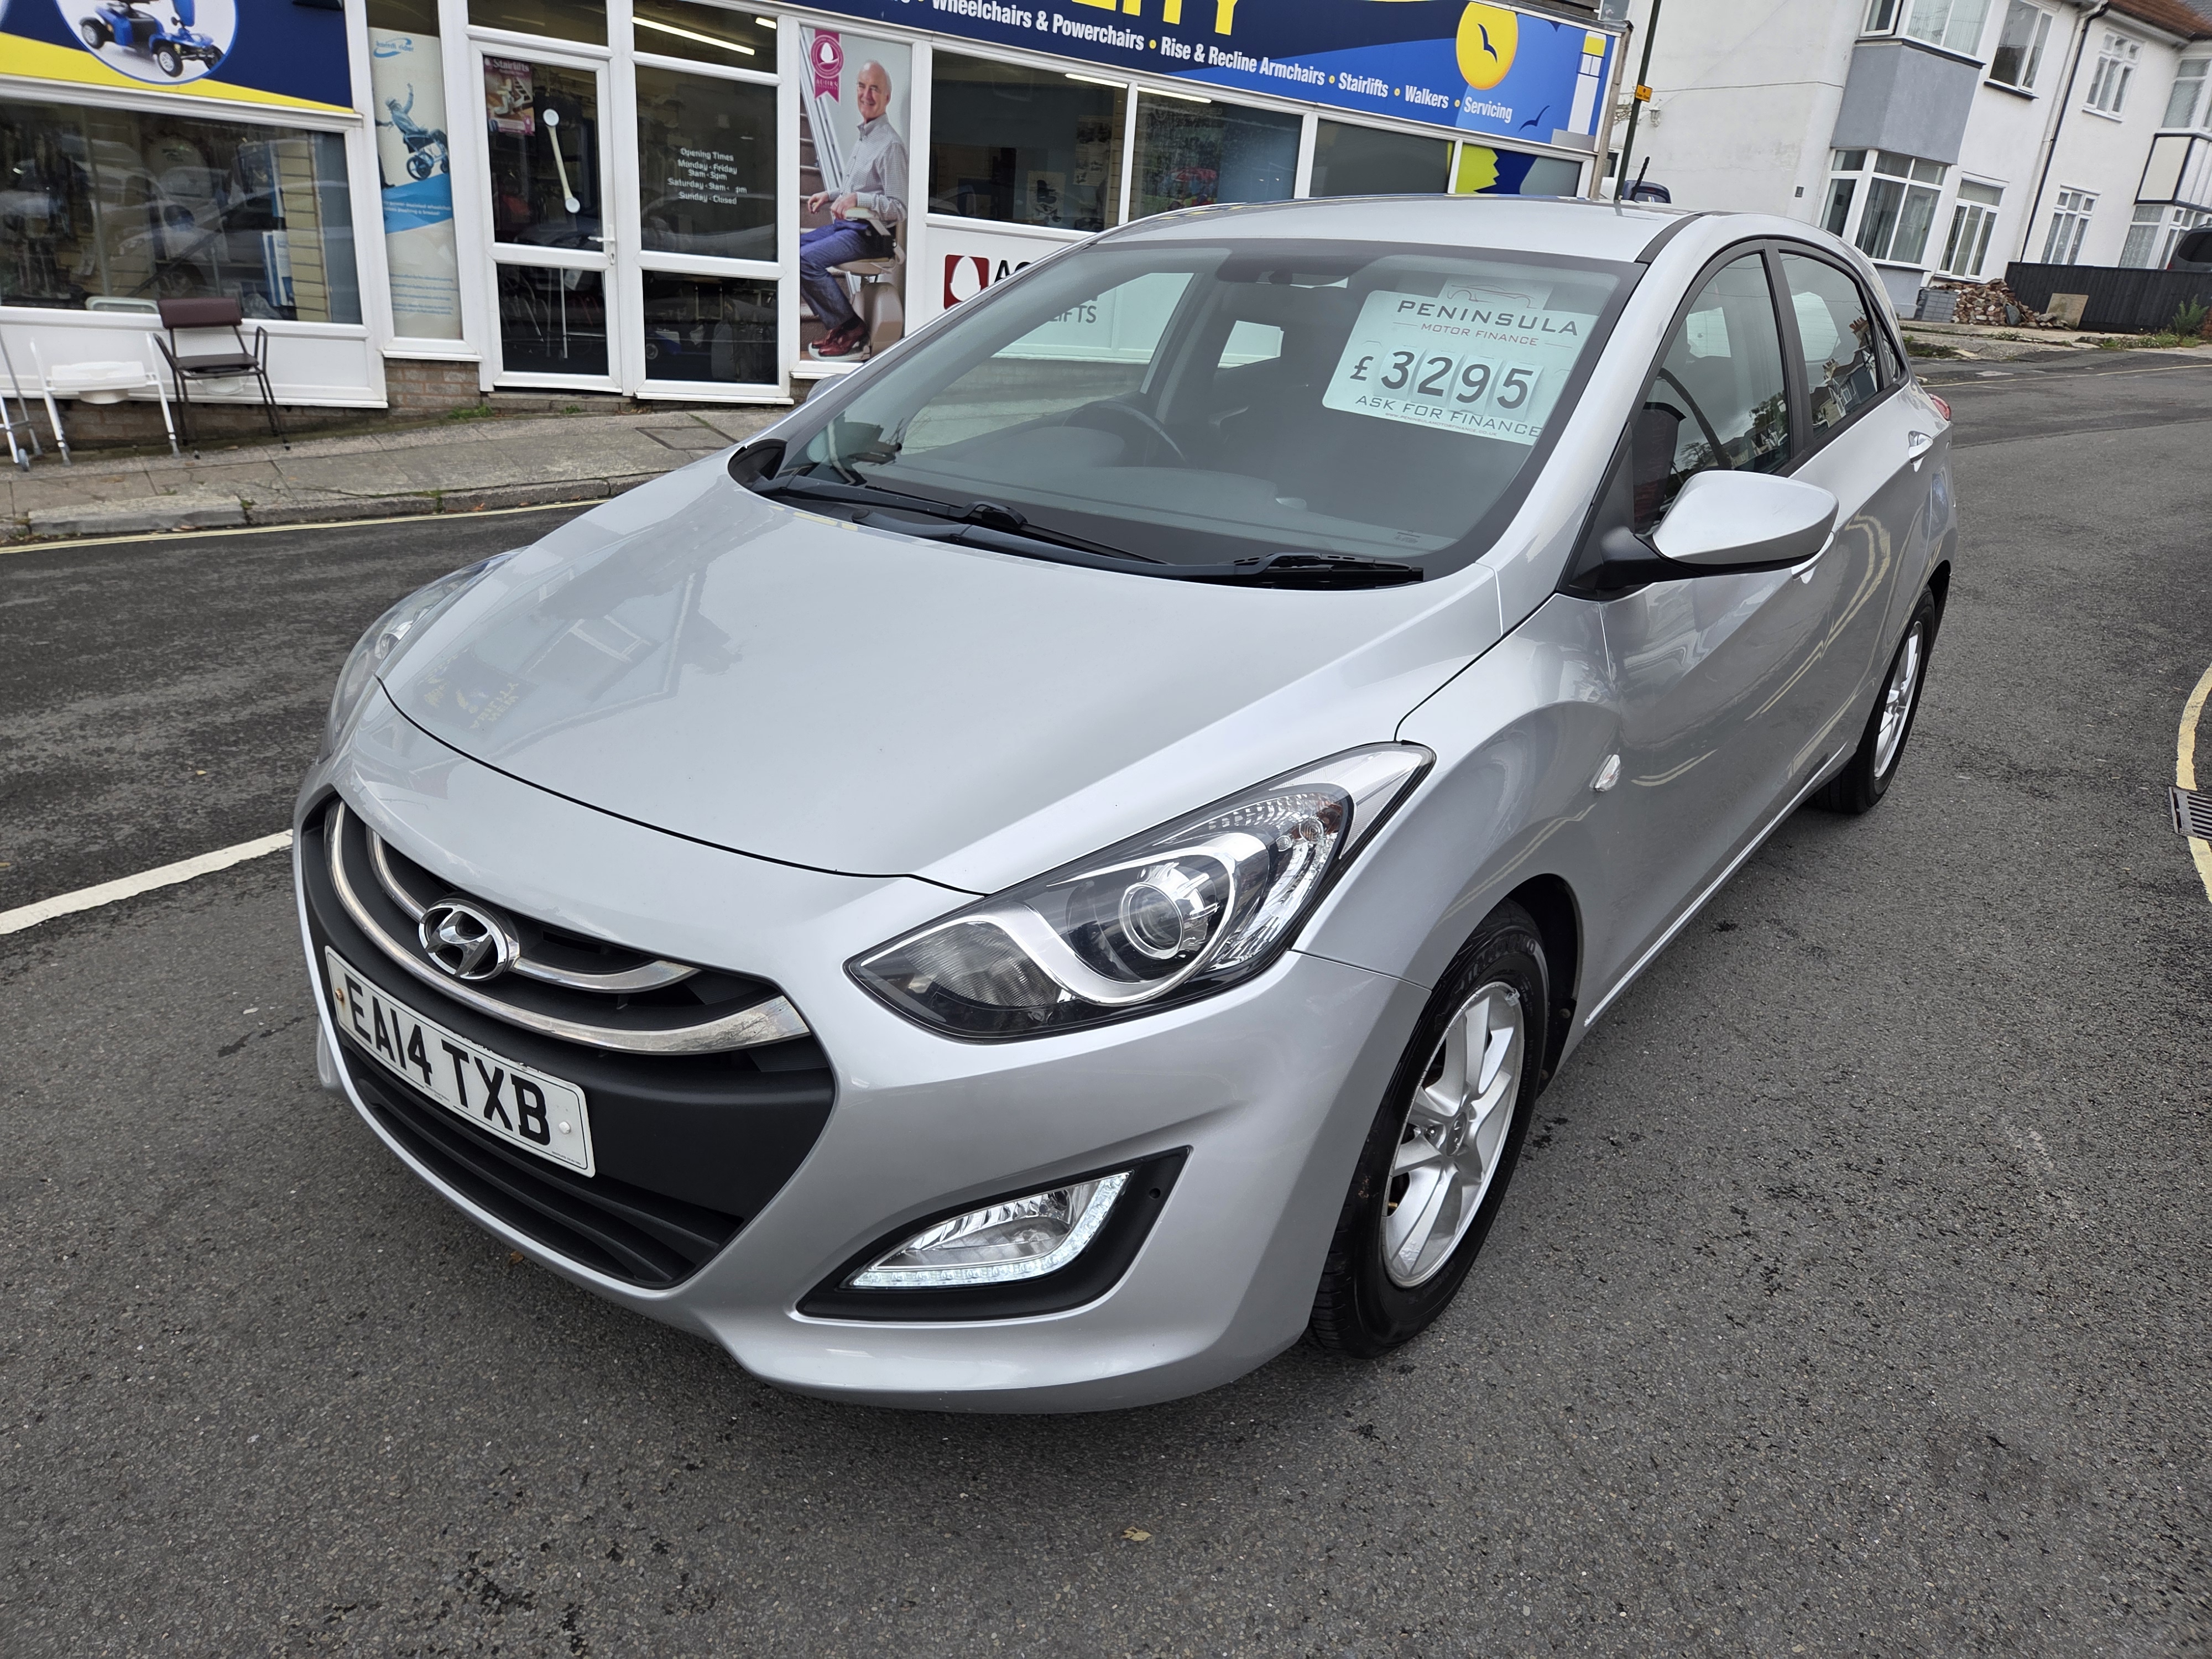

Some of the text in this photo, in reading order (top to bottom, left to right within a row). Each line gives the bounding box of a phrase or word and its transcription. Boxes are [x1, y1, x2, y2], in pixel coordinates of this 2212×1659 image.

[1035, 11, 1048, 32] &
[1052, 13, 1145, 51] Powerchairs
[1160, 36, 1191, 60] Rise
[1194, 43, 1205, 62] &
[1208, 46, 1257, 72] Recline
[1259, 57, 1326, 86] Armchairs
[1338, 72, 1389, 98] Stairlifts
[1405, 85, 1449, 109] Walkers
[1464, 96, 1513, 124] Servicing
[680, 148, 734, 161] Opening Times
[677, 159, 708, 171] Monday
[713, 164, 737, 175] Friday
[667, 177, 704, 190] Saturday
[678, 191, 708, 203] Sunday
[713, 194, 737, 205] Closed
[1397, 300, 1578, 336] PENINSULA
[1421, 323, 1538, 346] MOTOR FINANCE
[1355, 395, 1542, 437] ASK FOR FINANCE
[345, 973, 551, 1146] EA14 TXB
